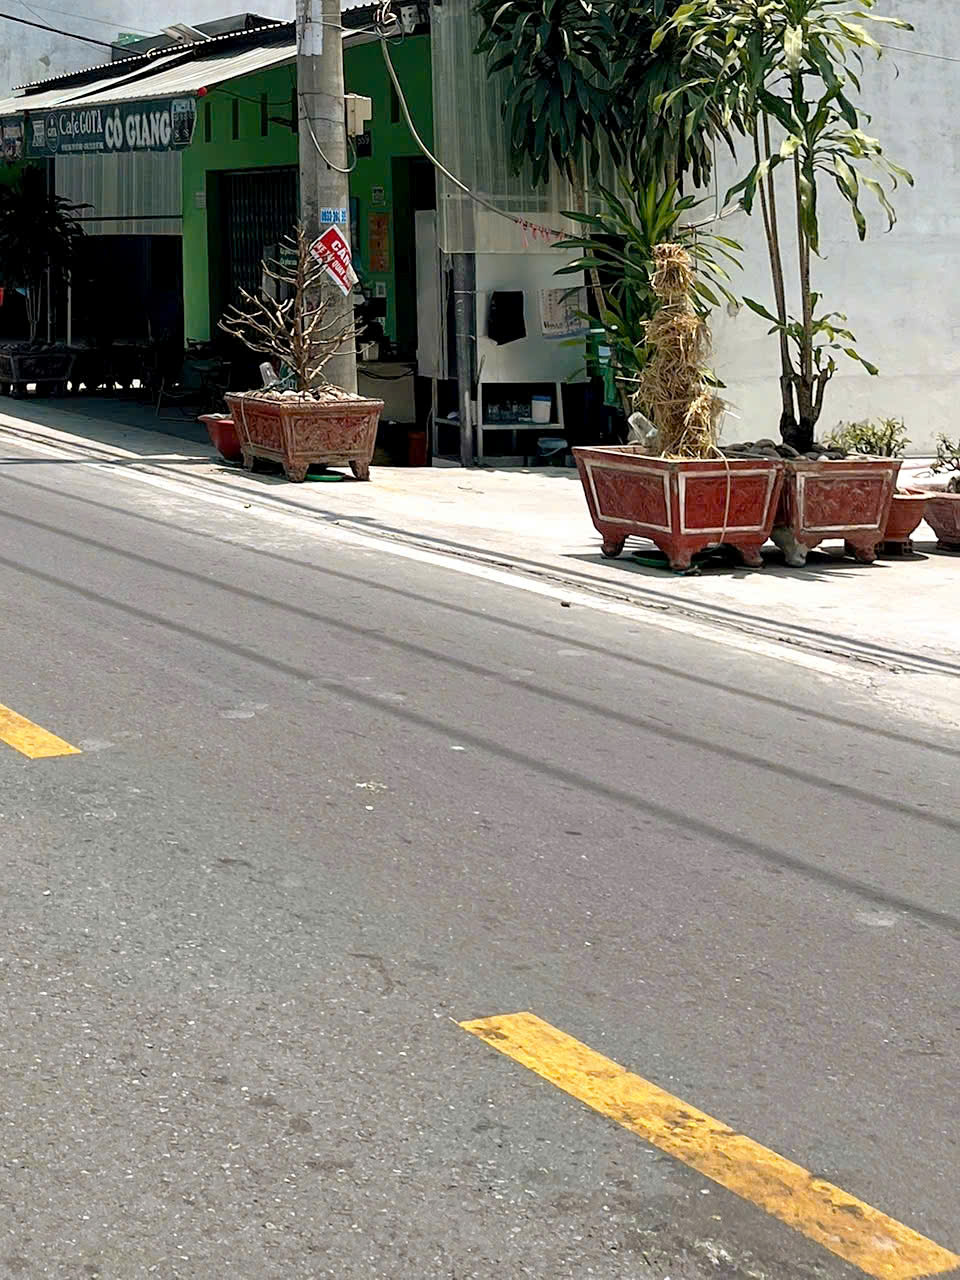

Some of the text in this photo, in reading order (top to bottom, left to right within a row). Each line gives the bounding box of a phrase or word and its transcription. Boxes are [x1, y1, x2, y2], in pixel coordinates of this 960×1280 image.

[80, 109, 103, 134] GOTA
[105, 108, 171, 149] CÔ GIANG
